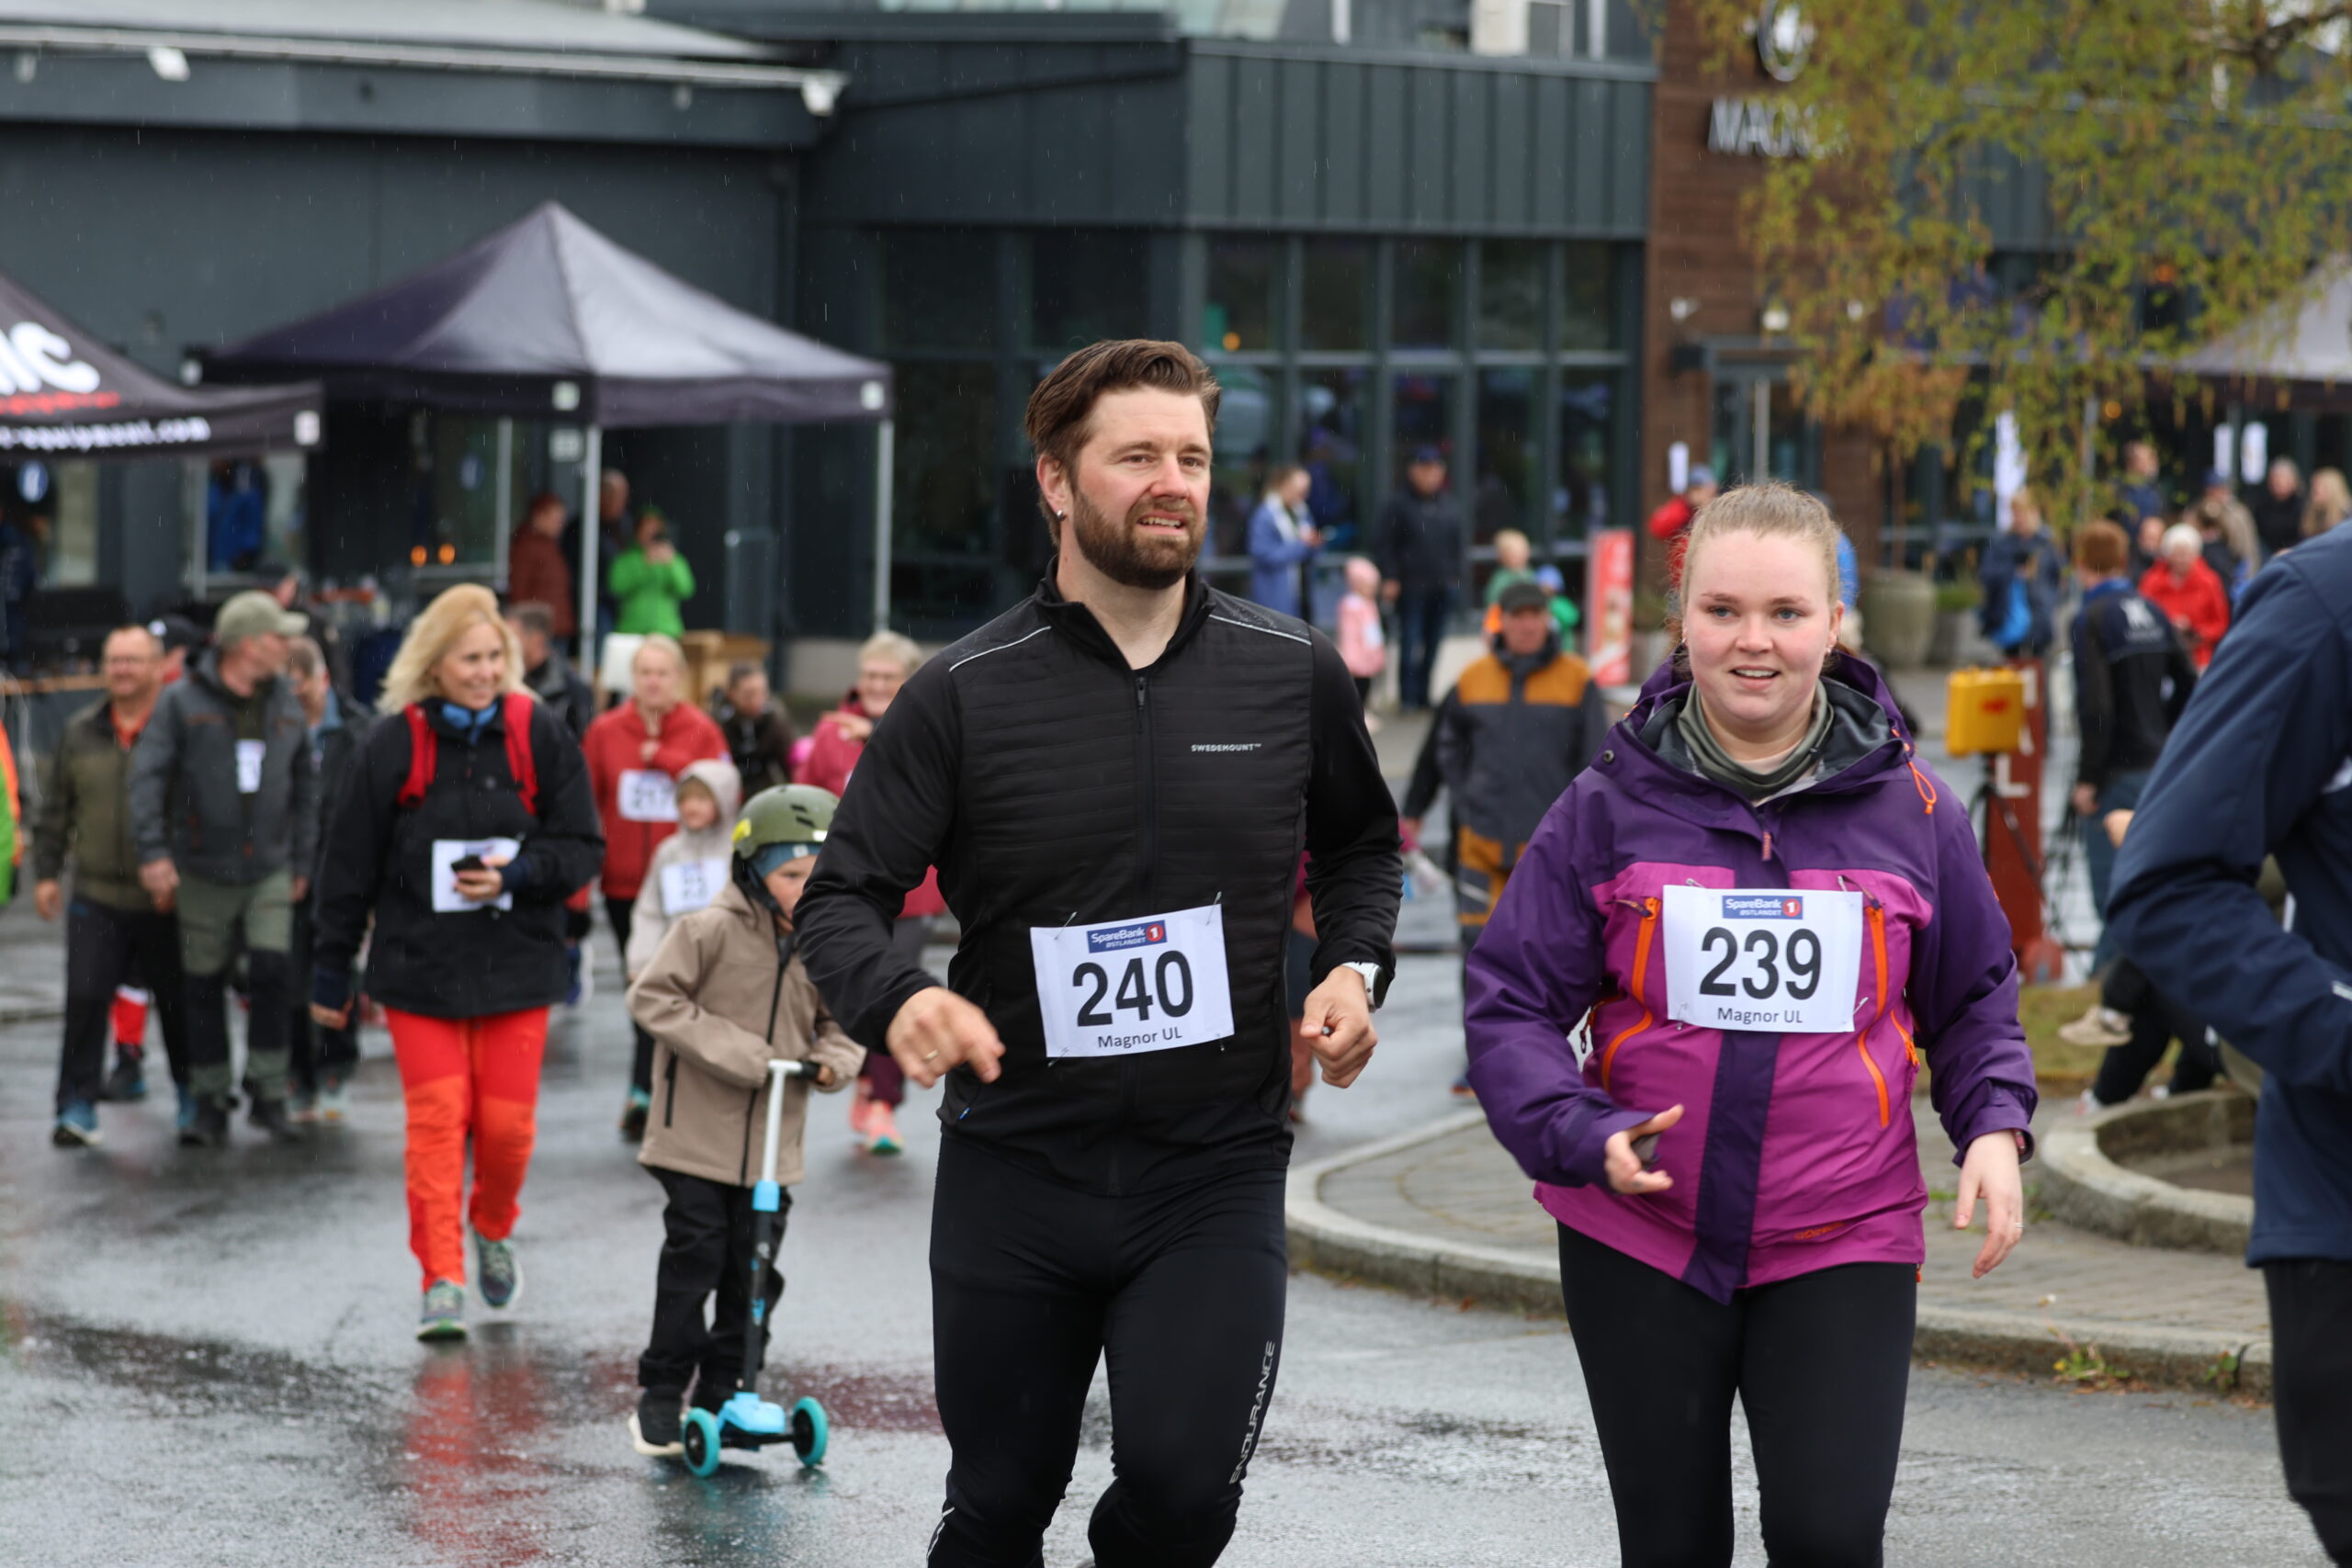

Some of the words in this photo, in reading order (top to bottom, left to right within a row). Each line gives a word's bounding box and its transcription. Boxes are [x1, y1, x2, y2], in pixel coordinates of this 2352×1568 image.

[1724, 897, 1782, 910] SpareBank
[1091, 927, 1147, 944] SpareBank
[1699, 926, 1822, 1000] 239
[1072, 950, 1193, 1028] 240
[1717, 1007, 1780, 1024] Magnor
[1784, 1010, 1804, 1023] UL
[1097, 1032, 1158, 1049] Magnor
[1161, 1026, 1182, 1041] UL
[1228, 1340, 1276, 1484] ENDURANCE
